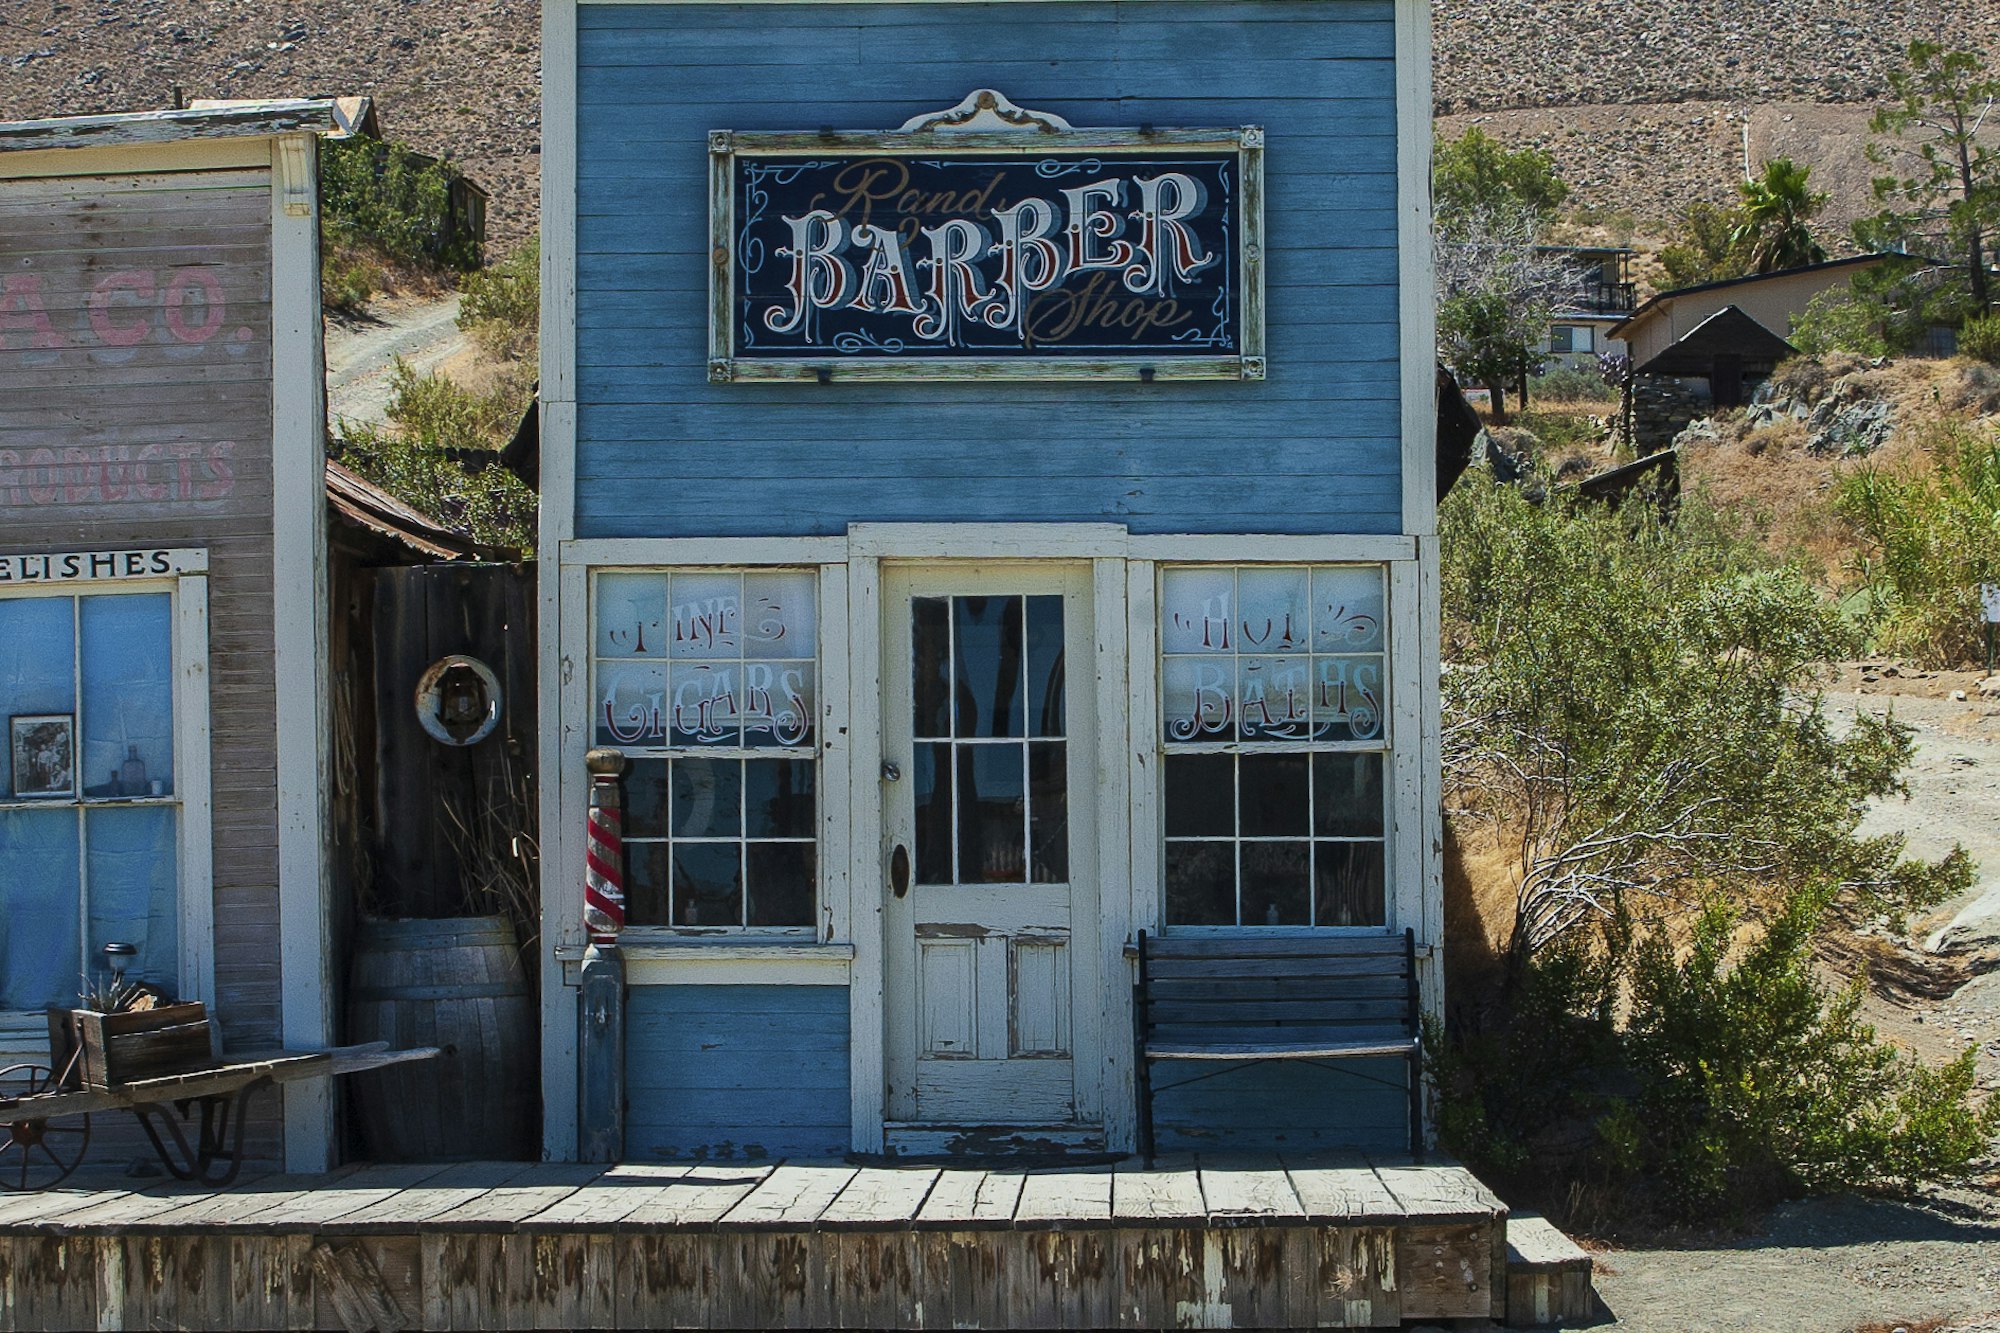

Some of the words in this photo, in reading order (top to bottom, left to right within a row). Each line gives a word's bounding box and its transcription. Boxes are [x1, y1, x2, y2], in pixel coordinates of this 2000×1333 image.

[811, 158, 1005, 238] Rand
[764, 172, 1214, 346] BARBER
[87, 267, 253, 346] CO.
[1024, 271, 1192, 348] Shop
[603, 664, 809, 744] CIGARS
[1170, 660, 1382, 740] BATHS
